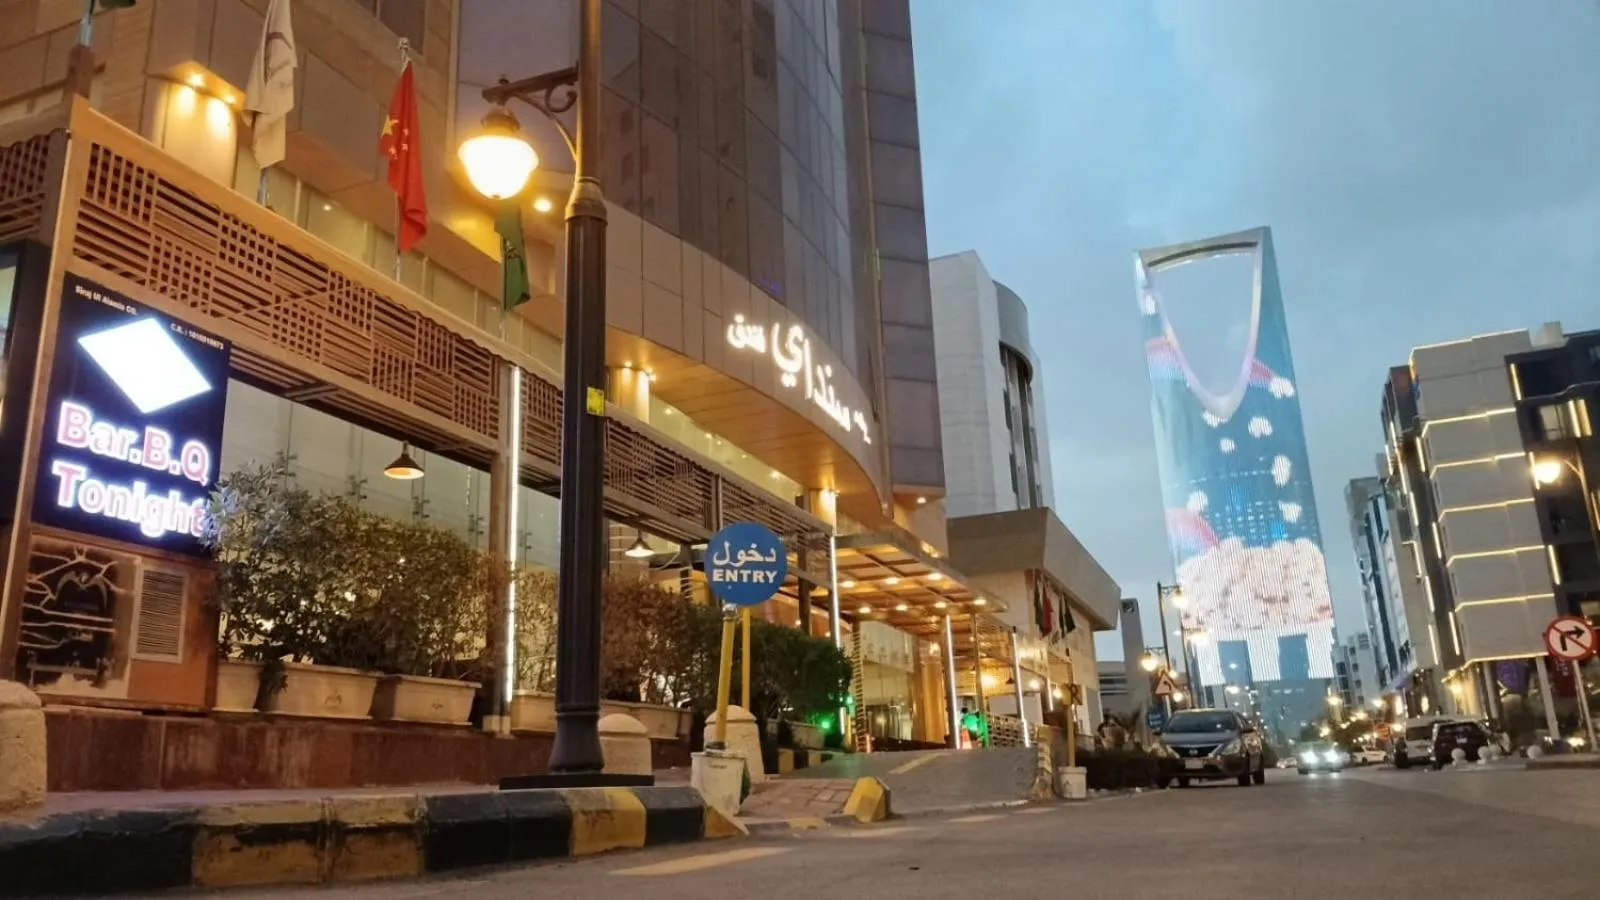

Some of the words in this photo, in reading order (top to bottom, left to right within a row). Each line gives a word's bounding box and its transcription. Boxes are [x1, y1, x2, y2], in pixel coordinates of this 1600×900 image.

[57, 401, 210, 485] Bar.B.Q
[51, 460, 208, 538] Tonight
[712, 540, 777, 567] دخول
[712, 568, 778, 584] ENTRY
